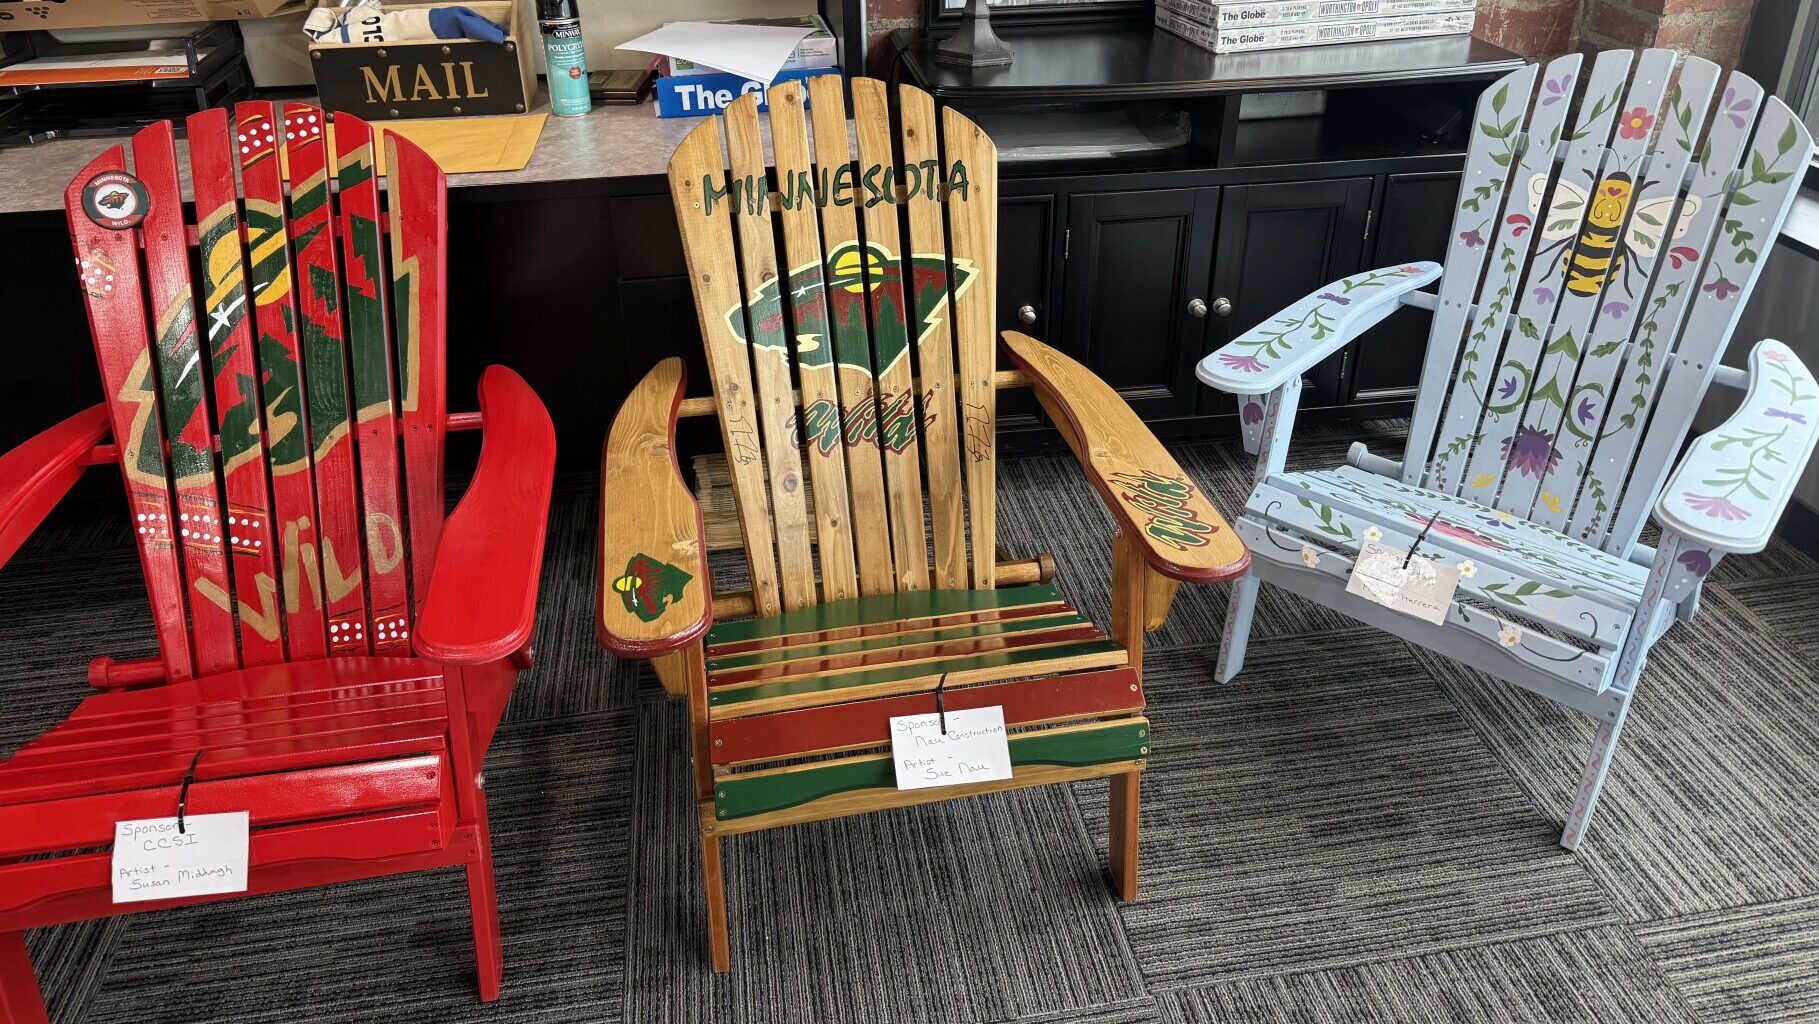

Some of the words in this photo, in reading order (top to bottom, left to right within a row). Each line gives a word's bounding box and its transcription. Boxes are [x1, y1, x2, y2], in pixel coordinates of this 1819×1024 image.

[1222, 13, 1239, 22] The
[1241, 10, 1266, 20] Globe
[1221, 36, 1238, 46] The
[1240, 33, 1265, 44] Globe
[360, 61, 488, 103] MAIL
[674, 84, 733, 111] The
[94, 175, 130, 186] MINNESOTA
[702, 159, 970, 216] MINNESOTA
[897, 719, 941, 735] Sponso
[947, 726, 1003, 741] Construction
[903, 757, 936, 771] Artist
[925, 767, 952, 780] Sue
[143, 833, 199, 851] CCSI
[119, 864, 156, 879] Artist
[128, 878, 170, 891] Susan
